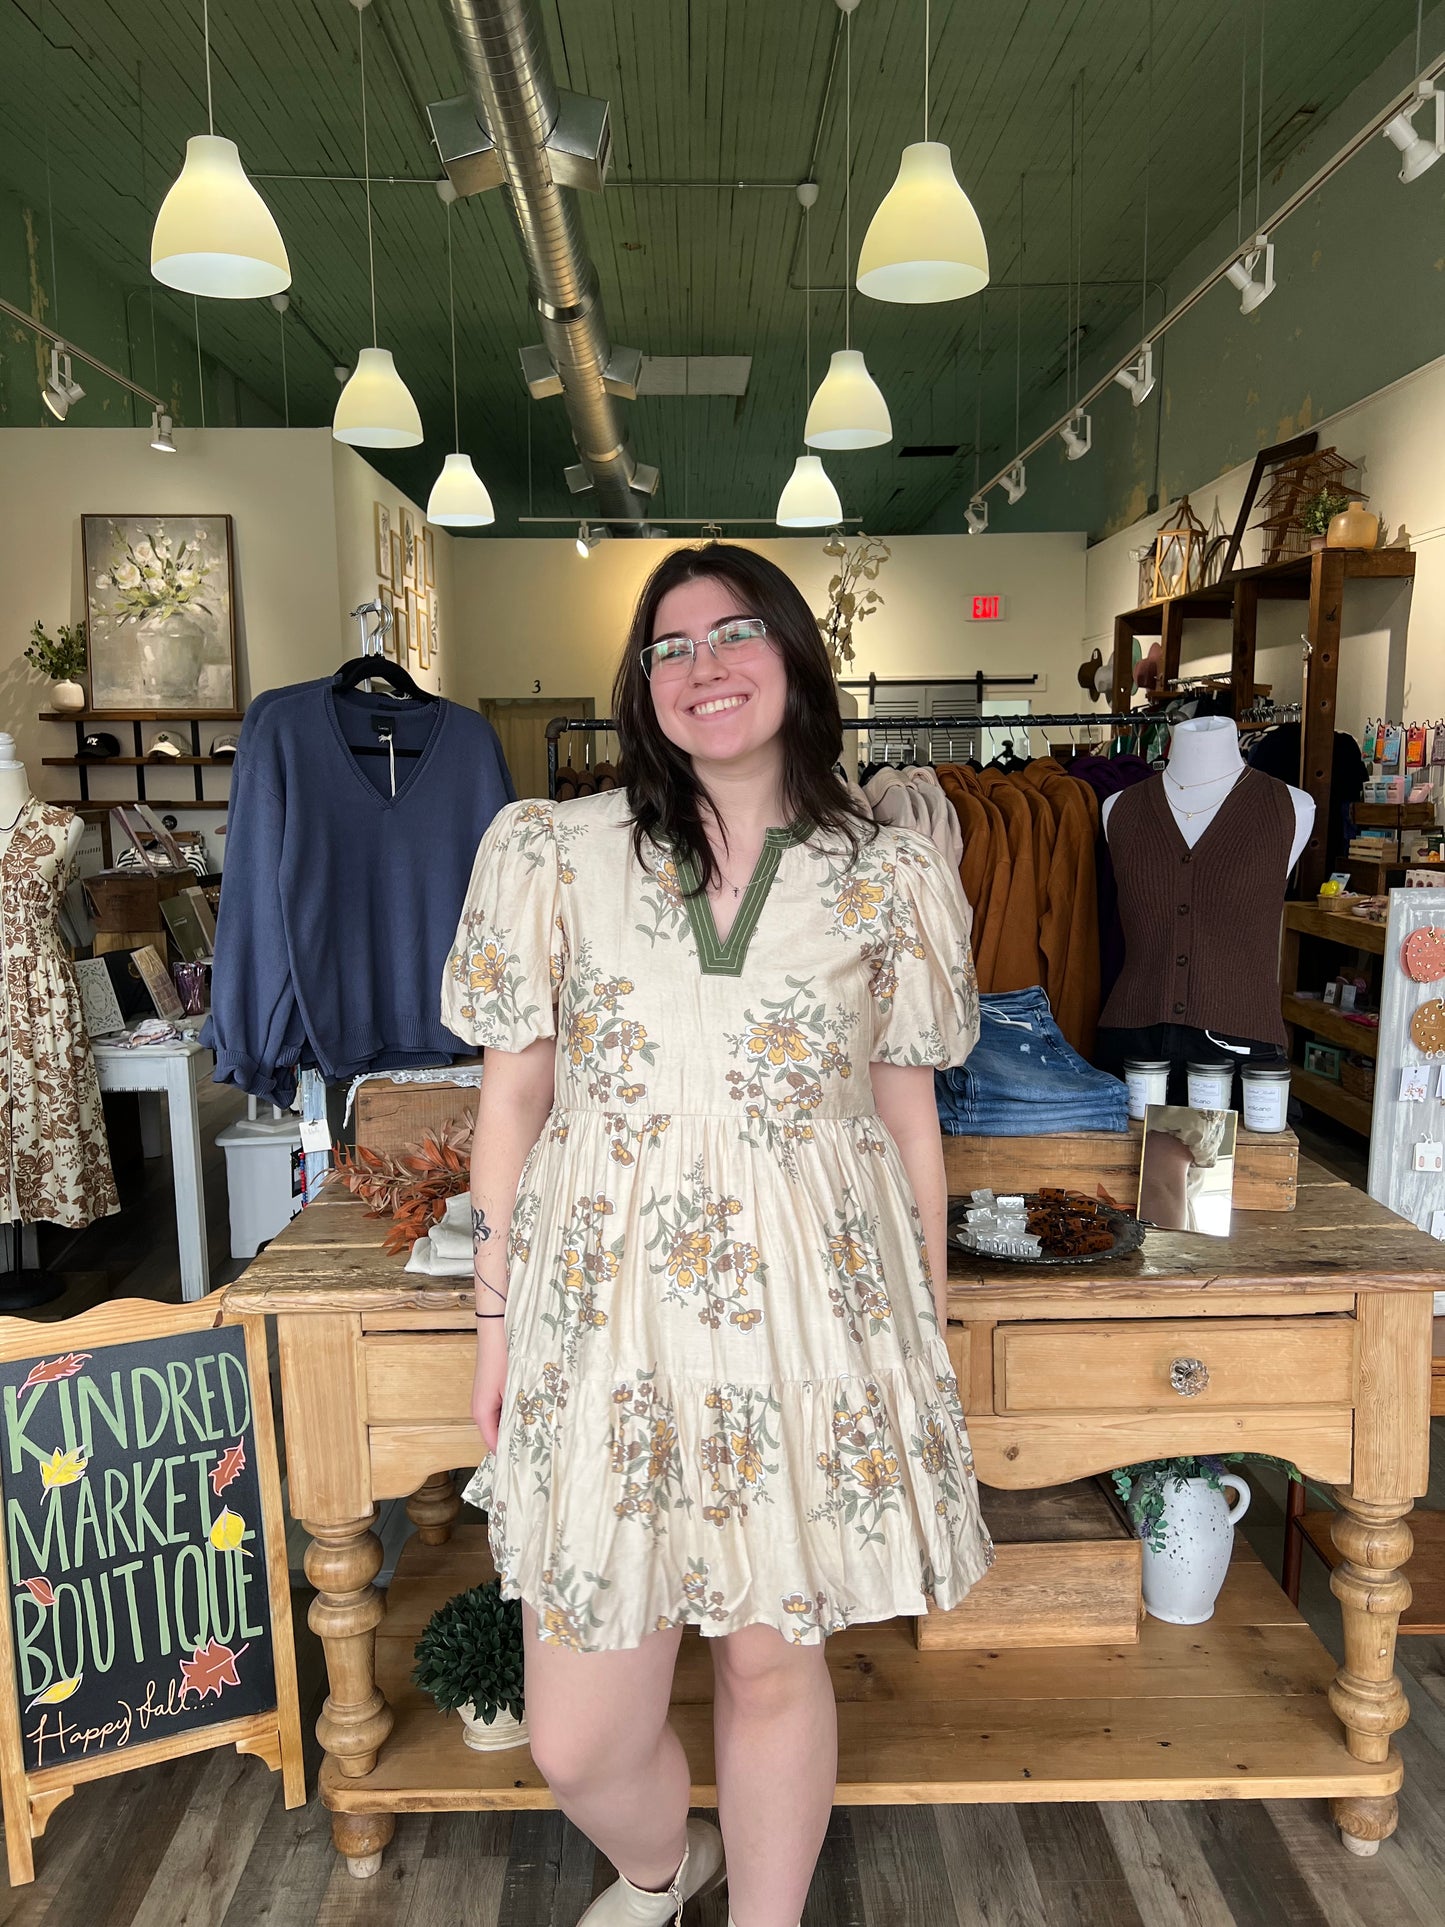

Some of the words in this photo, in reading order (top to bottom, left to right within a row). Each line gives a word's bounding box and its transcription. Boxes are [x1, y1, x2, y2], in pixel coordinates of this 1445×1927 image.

[972, 596, 1000, 619] EXIT
[531, 680, 541, 694] 3
[86, 736, 99, 746] NY
[3, 1352, 251, 1474] KINDRED
[8, 1450, 217, 1585] MARKET
[14, 1529, 264, 1696] BOUTIQUE
[26, 1701, 132, 1767] Happy
